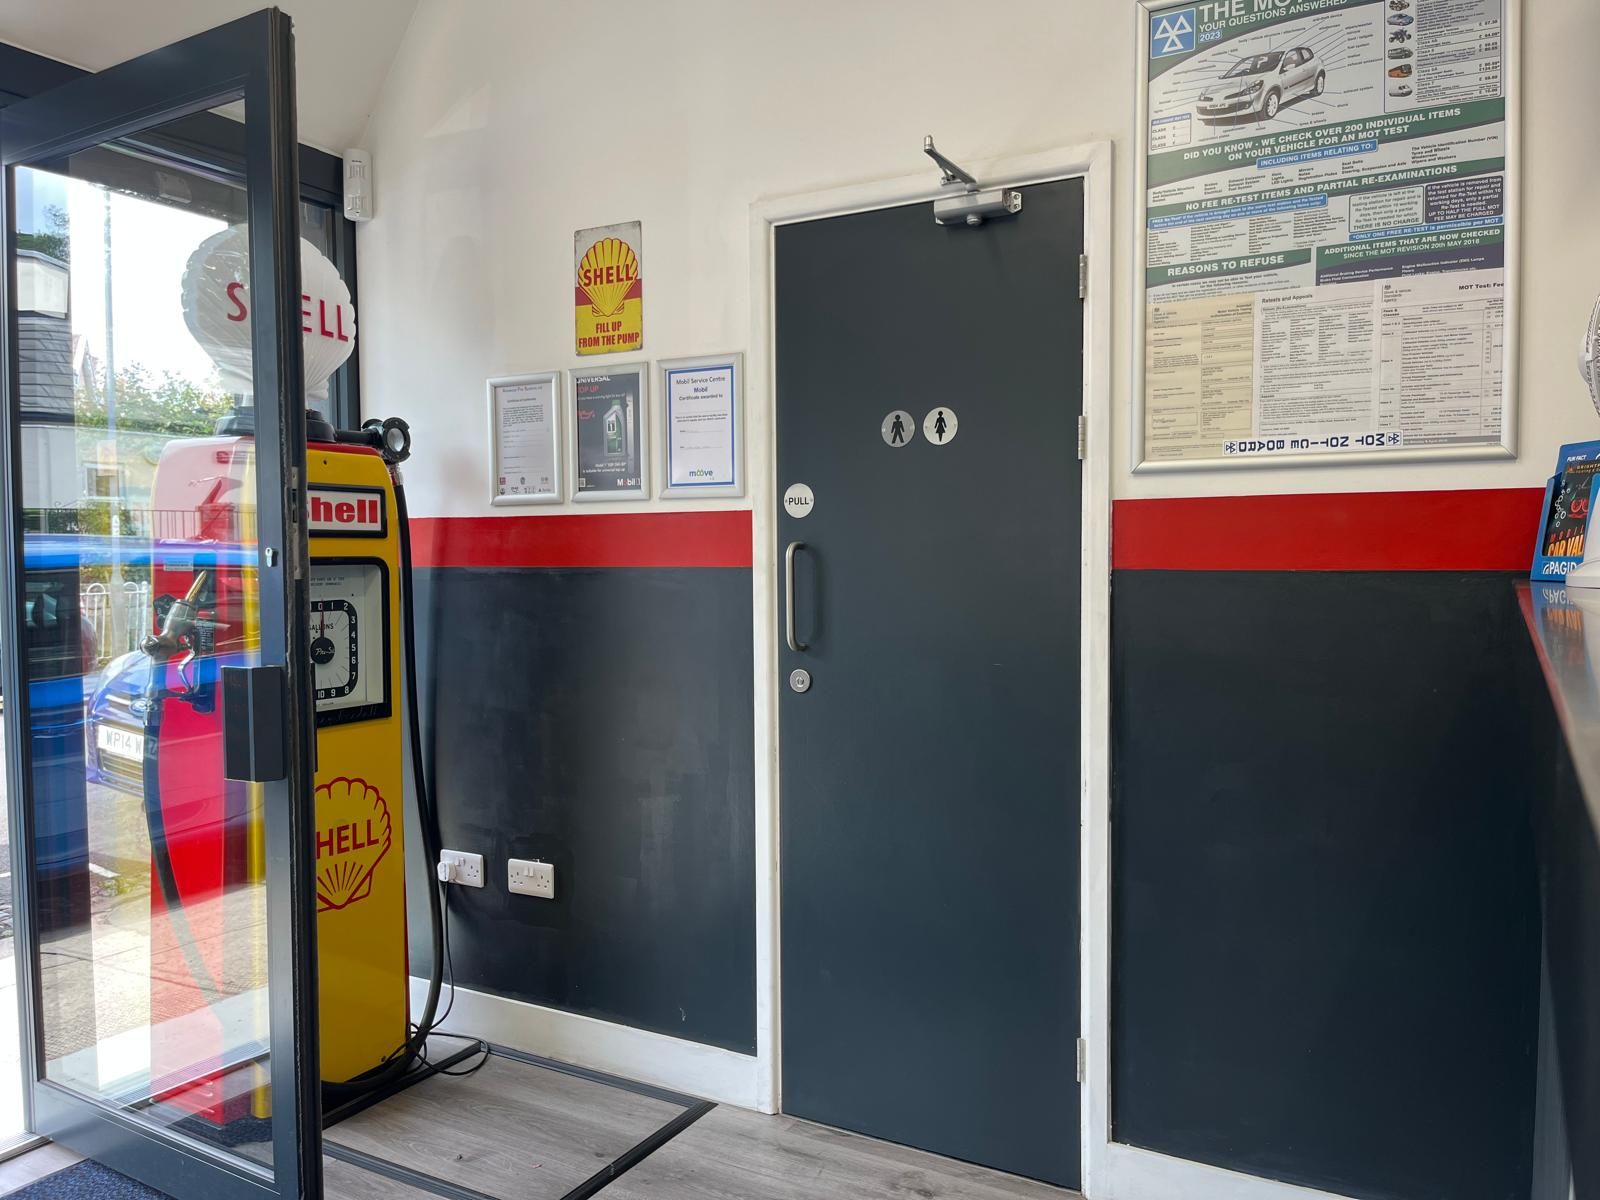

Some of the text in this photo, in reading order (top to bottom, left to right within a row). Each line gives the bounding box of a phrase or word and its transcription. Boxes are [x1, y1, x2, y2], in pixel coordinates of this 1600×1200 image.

[1200, 0, 1245, 22] THE
[1200, 20, 1226, 32] YOUR
[1228, 10, 1286, 27] QUESTIONS
[1200, 31, 1221, 41] 2023
[1184, 108, 1461, 160] DID YOU KNOW WE CHECK OVER 200 INDIVIDUAL ITEMS
[1228, 125, 1409, 161] ON YOUR VEHICLE FOR AN MOT TEST
[1260, 155, 1298, 166] INCLUDING
[1300, 151, 1322, 160] ITEMS
[1324, 144, 1359, 156] RELATING
[1186, 166, 1457, 210] NO FEE RE-TEST ITEMS AND PARTIAL RE-EXAMINATIONS
[1393, 218, 1420, 226] CHARGE
[1467, 210, 1494, 218] CHARGED
[1372, 230, 1385, 238] ONE
[1436, 222, 1472, 230] permissible
[1324, 244, 1370, 255] ADDITIONAL
[1372, 240, 1397, 248] ITEMS
[1400, 237, 1420, 246] THAT
[1440, 232, 1459, 240] NOW
[1461, 229, 1500, 238] CHECKED
[1344, 251, 1364, 260] SINCE
[1397, 244, 1430, 253] REVISION
[1168, 255, 1284, 277] REASONS TO REFUSE
[583, 264, 634, 288] SHELL
[226, 281, 348, 342] SELL
[596, 321, 622, 334] FILL UP
[578, 332, 640, 348] FROM THE PUMP
[1238, 433, 1385, 452] MOT NOTICE BOARD
[617, 478, 636, 486] Mobil
[788, 497, 810, 506] PULL
[307, 496, 378, 524] hell
[1548, 540, 1566, 556] CAR
[1550, 561, 1576, 576] PAGID
[344, 602, 348, 610] 2
[352, 616, 356, 624] 3
[351, 631, 356, 639] 4
[352, 644, 356, 652] 5
[352, 656, 356, 664] 6
[352, 672, 356, 680] 7
[318, 690, 324, 698] 10
[344, 686, 350, 694] 8
[106, 729, 132, 749] WP14
[316, 819, 380, 860] HELL
